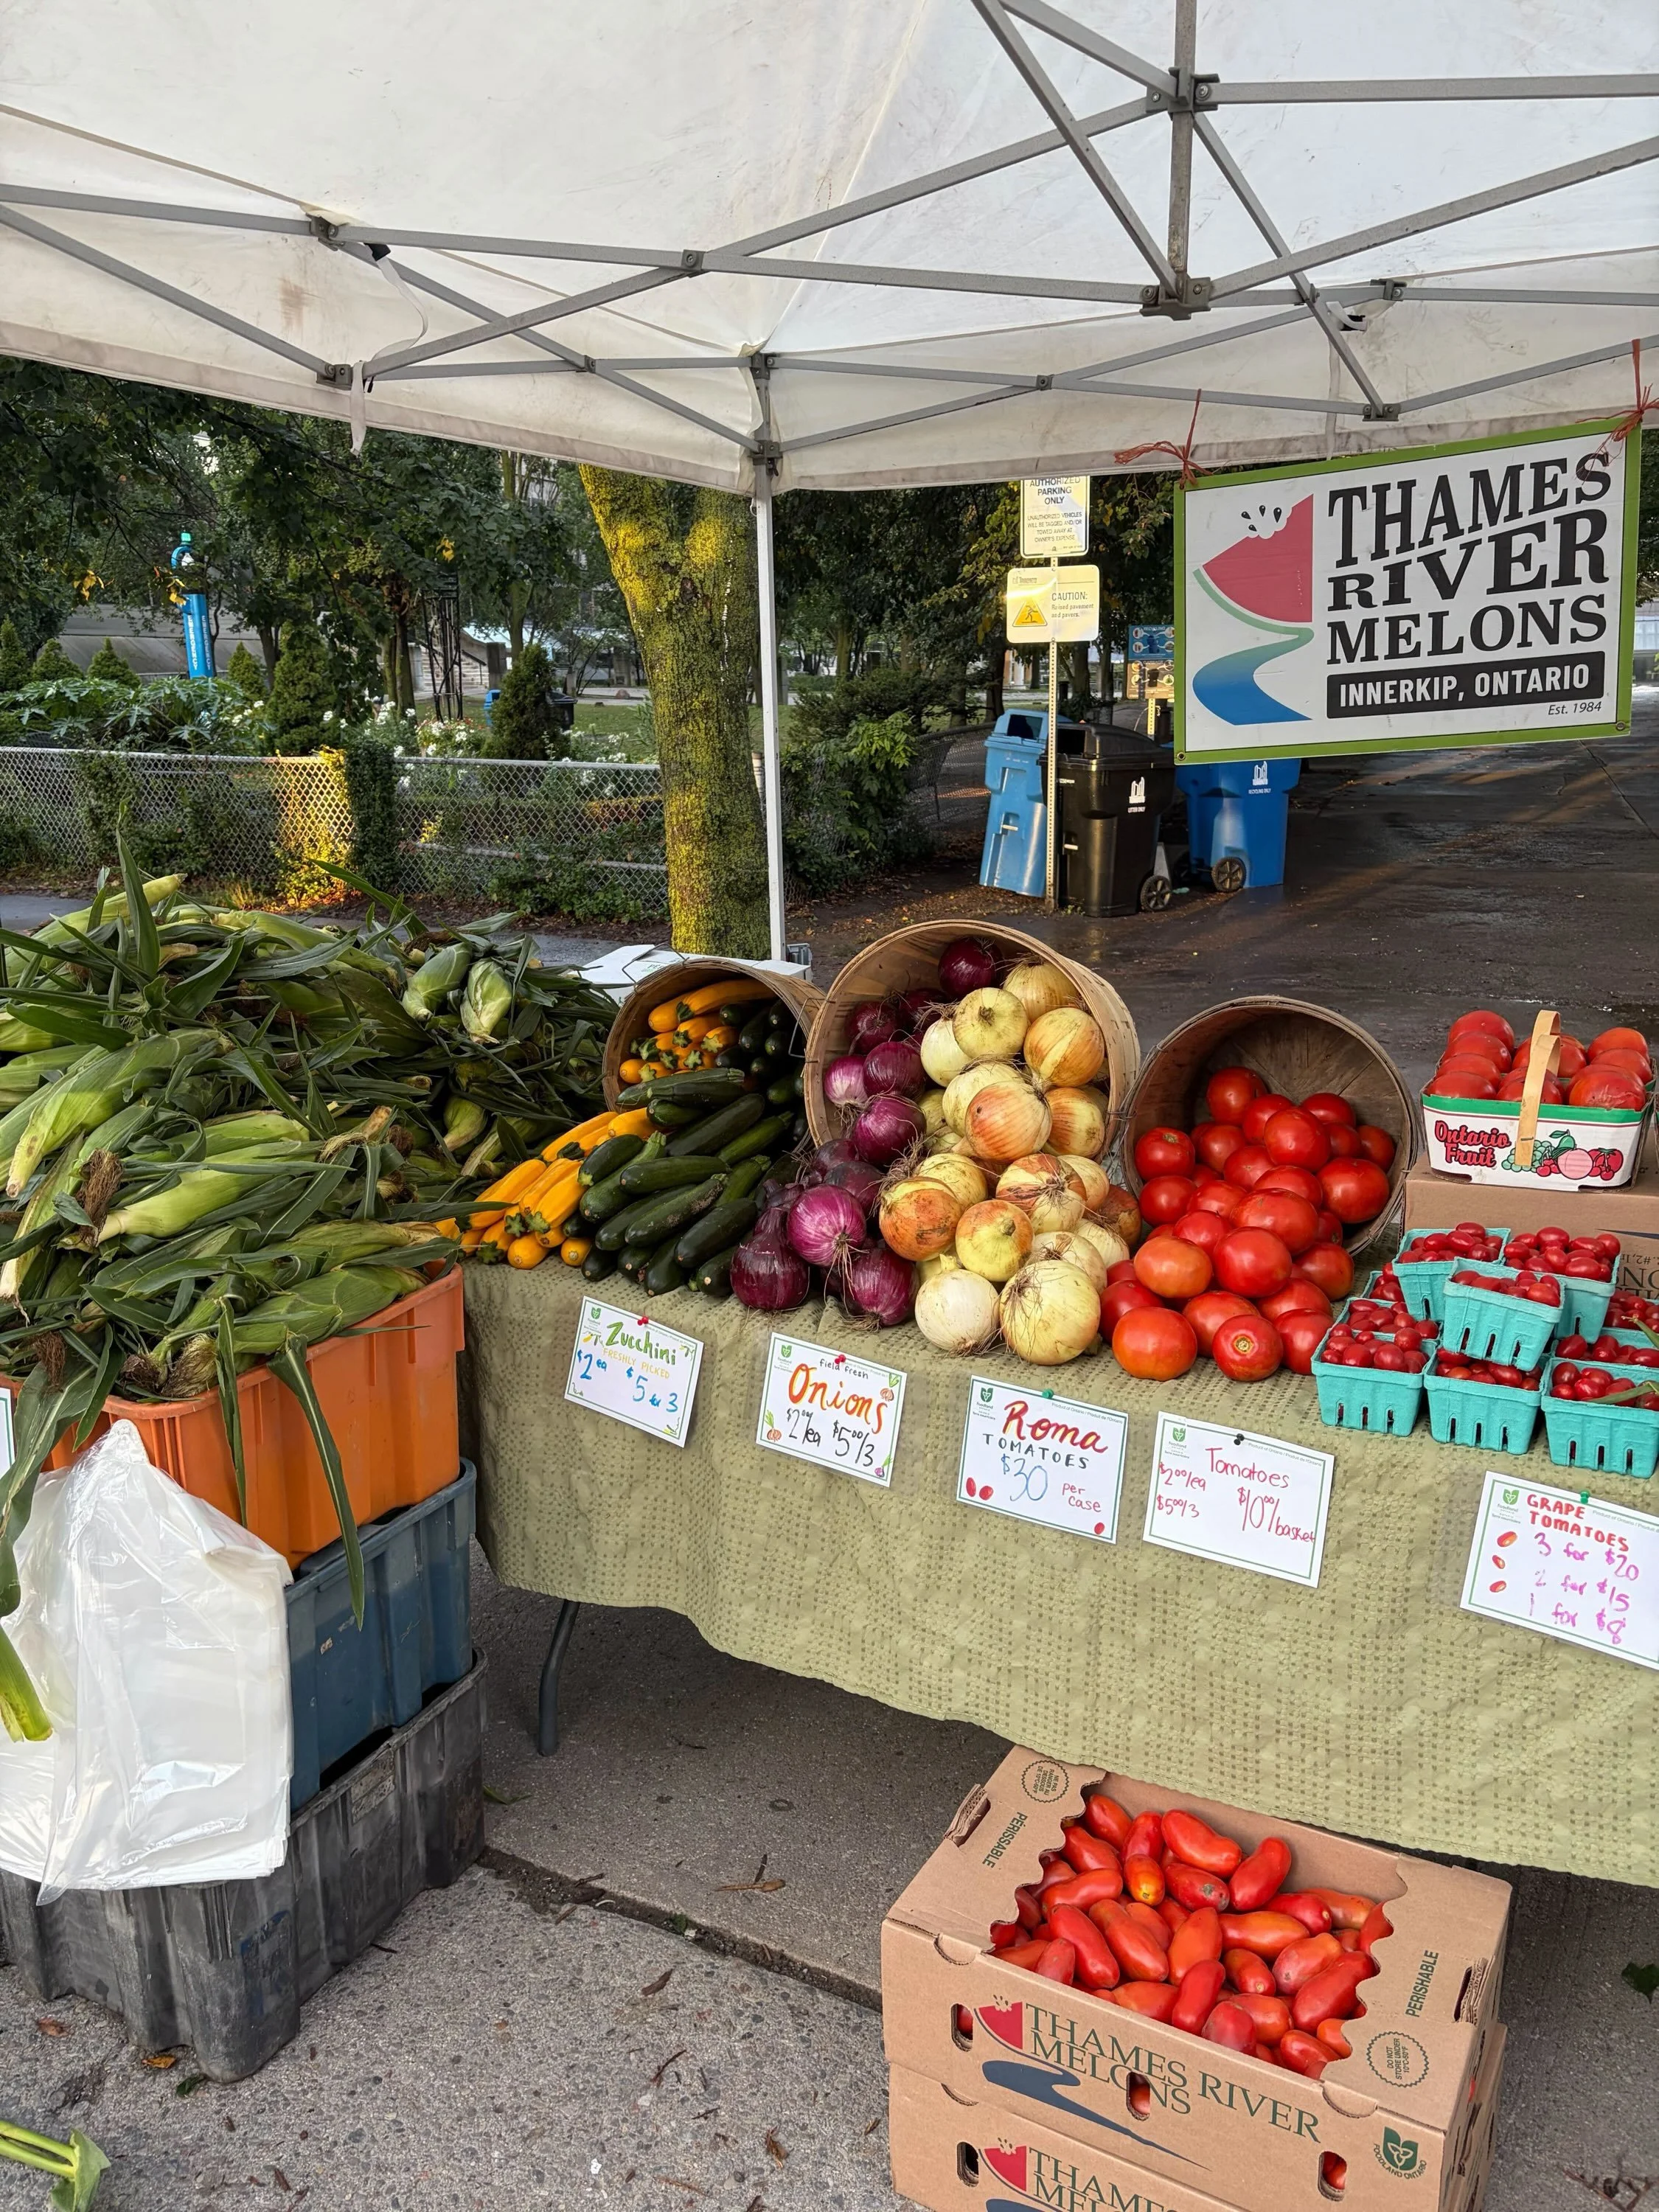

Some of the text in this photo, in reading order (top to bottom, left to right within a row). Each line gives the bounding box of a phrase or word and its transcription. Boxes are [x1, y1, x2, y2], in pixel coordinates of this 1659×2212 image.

[1030, 477, 1081, 487] AUTHORIZED
[1037, 487, 1072, 495] PARKING
[1044, 496, 1065, 504] ONLY
[1328, 453, 1612, 568] THAMES
[1327, 509, 1610, 612] RIVER
[1051, 591, 1088, 601] CAUTION:
[187, 615, 198, 670] EMERGENCY
[201, 615, 211, 670] EMERGENCY
[1327, 594, 1607, 665] MELONS
[1339, 664, 1590, 708] INNERKIP, ONTARIO
[1548, 700, 1602, 715] Est. 1984
[1434, 1120, 1512, 1149] Ontario
[1444, 1143, 1497, 1167] Fruit
[605, 1321, 676, 1366] Zucchini
[602, 1348, 670, 1380] FRESHLY PICKED
[819, 1358, 841, 1371] field
[844, 1366, 869, 1380] fresh
[666, 1392, 678, 1413] 3
[788, 1363, 888, 1434] Onions
[1002, 1400, 1108, 1453] Roma
[982, 1433, 1090, 1470] TOMATOES
[1205, 1447, 1290, 1489] Tomatoes
[1001, 1453, 1048, 1501] $30
[1062, 1482, 1086, 1495] per
[1527, 1493, 1585, 1520] GRAPE
[1529, 1511, 1630, 1553] TOMATOES
[1534, 1531, 1639, 1581] 3 for $20
[1534, 1569, 1630, 1612] 2 for $15
[1528, 1593, 1627, 1645] 1 for $8
[1037, 1765, 1043, 1773] DE
[1038, 1770, 1048, 1792] DESSOUS
[1043, 1769, 1055, 1796] RANGER AU
[981, 1812, 1028, 1868] PÉRISSABLE
[1405, 1950, 1439, 2018] PERISHABLE
[1026, 2002, 1321, 2143] THAMES RIVER
[1385, 2045, 1394, 2069] DO NOT
[1394, 2059, 1402, 2080] STORE
[1373, 2143, 1427, 2180] FOODLAND ONTARIO
